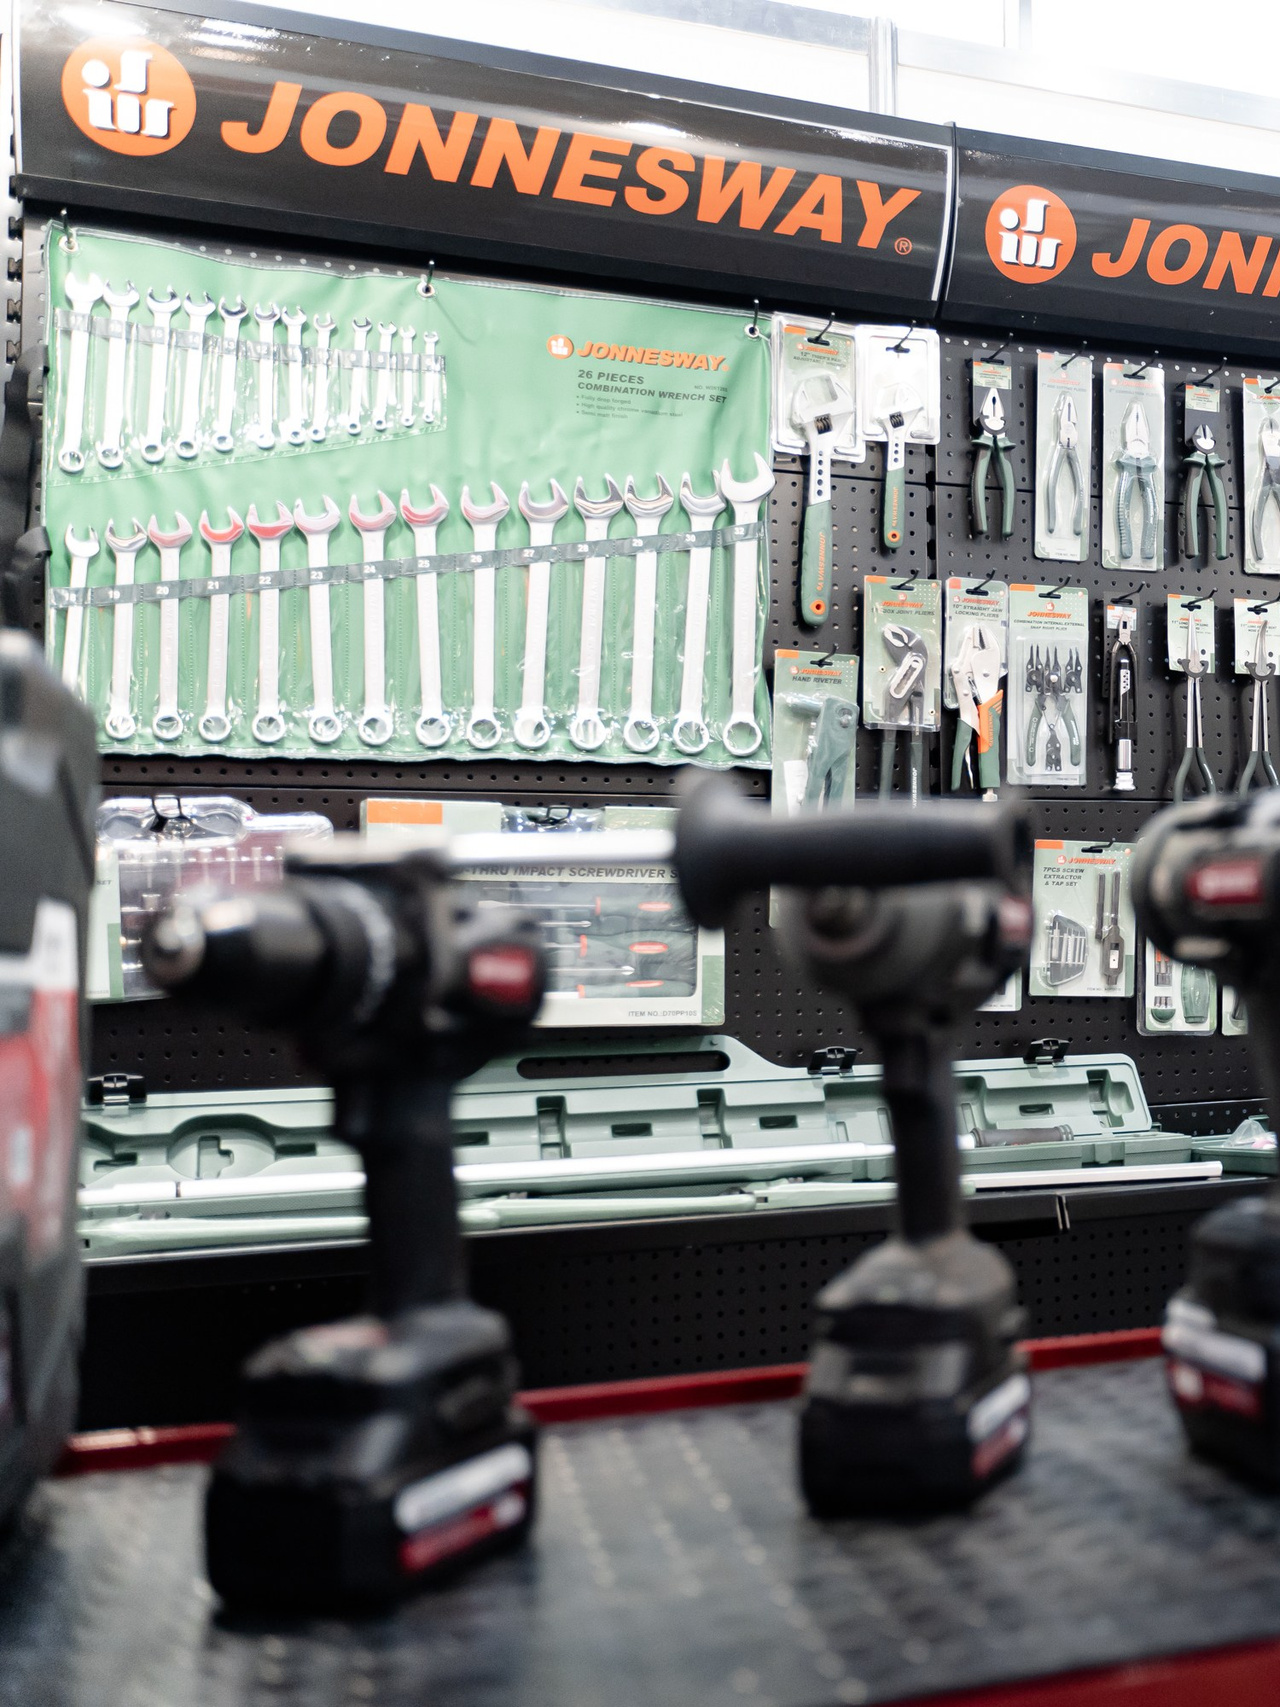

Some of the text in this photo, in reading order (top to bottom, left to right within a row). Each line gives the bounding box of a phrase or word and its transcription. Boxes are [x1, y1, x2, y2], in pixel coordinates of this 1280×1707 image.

[220, 80, 923, 250] JONNESWAY
[577, 340, 728, 371] JONNESWAY
[577, 369, 645, 385] 26 PIECES
[577, 381, 728, 404] COMBINATION WRENCH SET
[156, 586, 169, 596] 20
[207, 581, 220, 590] 21
[259, 576, 271, 585] 22
[310, 570, 323, 580] 23
[363, 565, 376, 574] 24
[418, 559, 430, 568] 25
[470, 555, 482, 564] 26
[523, 549, 535, 558] 27
[632, 538, 643, 547] 29
[685, 534, 696, 543] 30
[734, 527, 745, 536] 32
[914, 609, 935, 617] PLIERS
[955, 610, 979, 618] LOCKING
[963, 604, 990, 612] STRAIGHT
[813, 677, 842, 685] RIVETER
[1068, 857, 1116, 866] JONNESWAY
[513, 866, 565, 877] IMPACT
[568, 867, 666, 879] SCREWDRIVER
